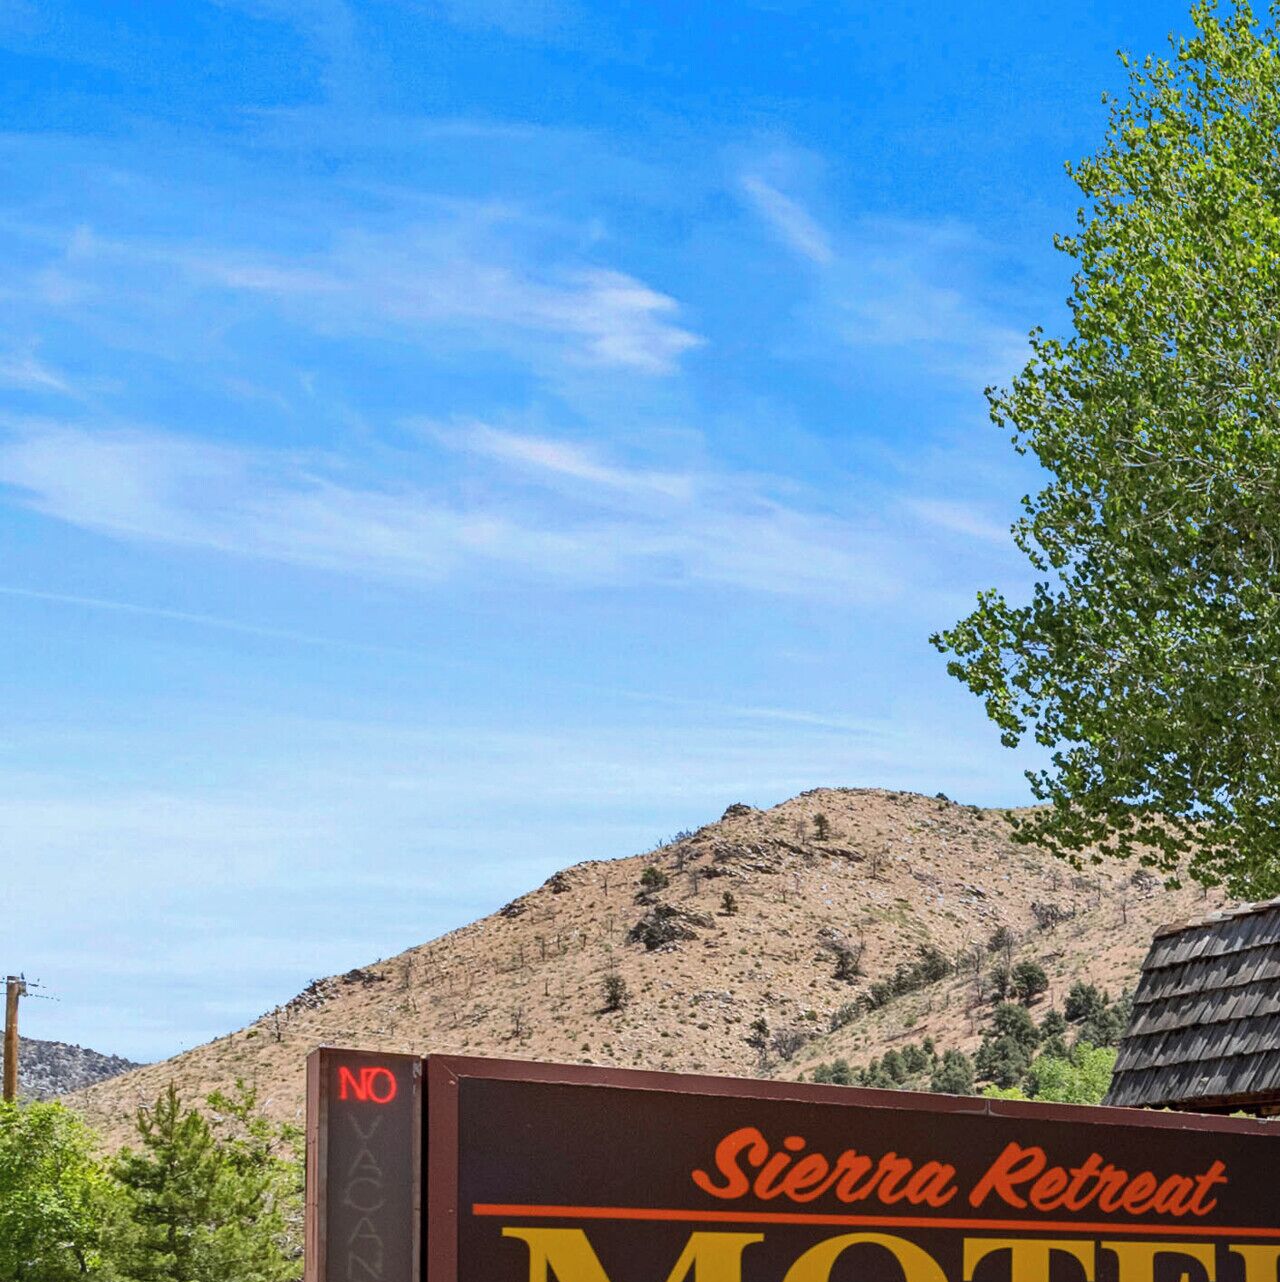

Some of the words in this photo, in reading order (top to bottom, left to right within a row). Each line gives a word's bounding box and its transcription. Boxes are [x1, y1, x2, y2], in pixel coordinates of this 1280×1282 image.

[338, 1066, 398, 1105] NO
[691, 1126, 959, 1209] Sierra
[968, 1142, 1229, 1217] Retreat
